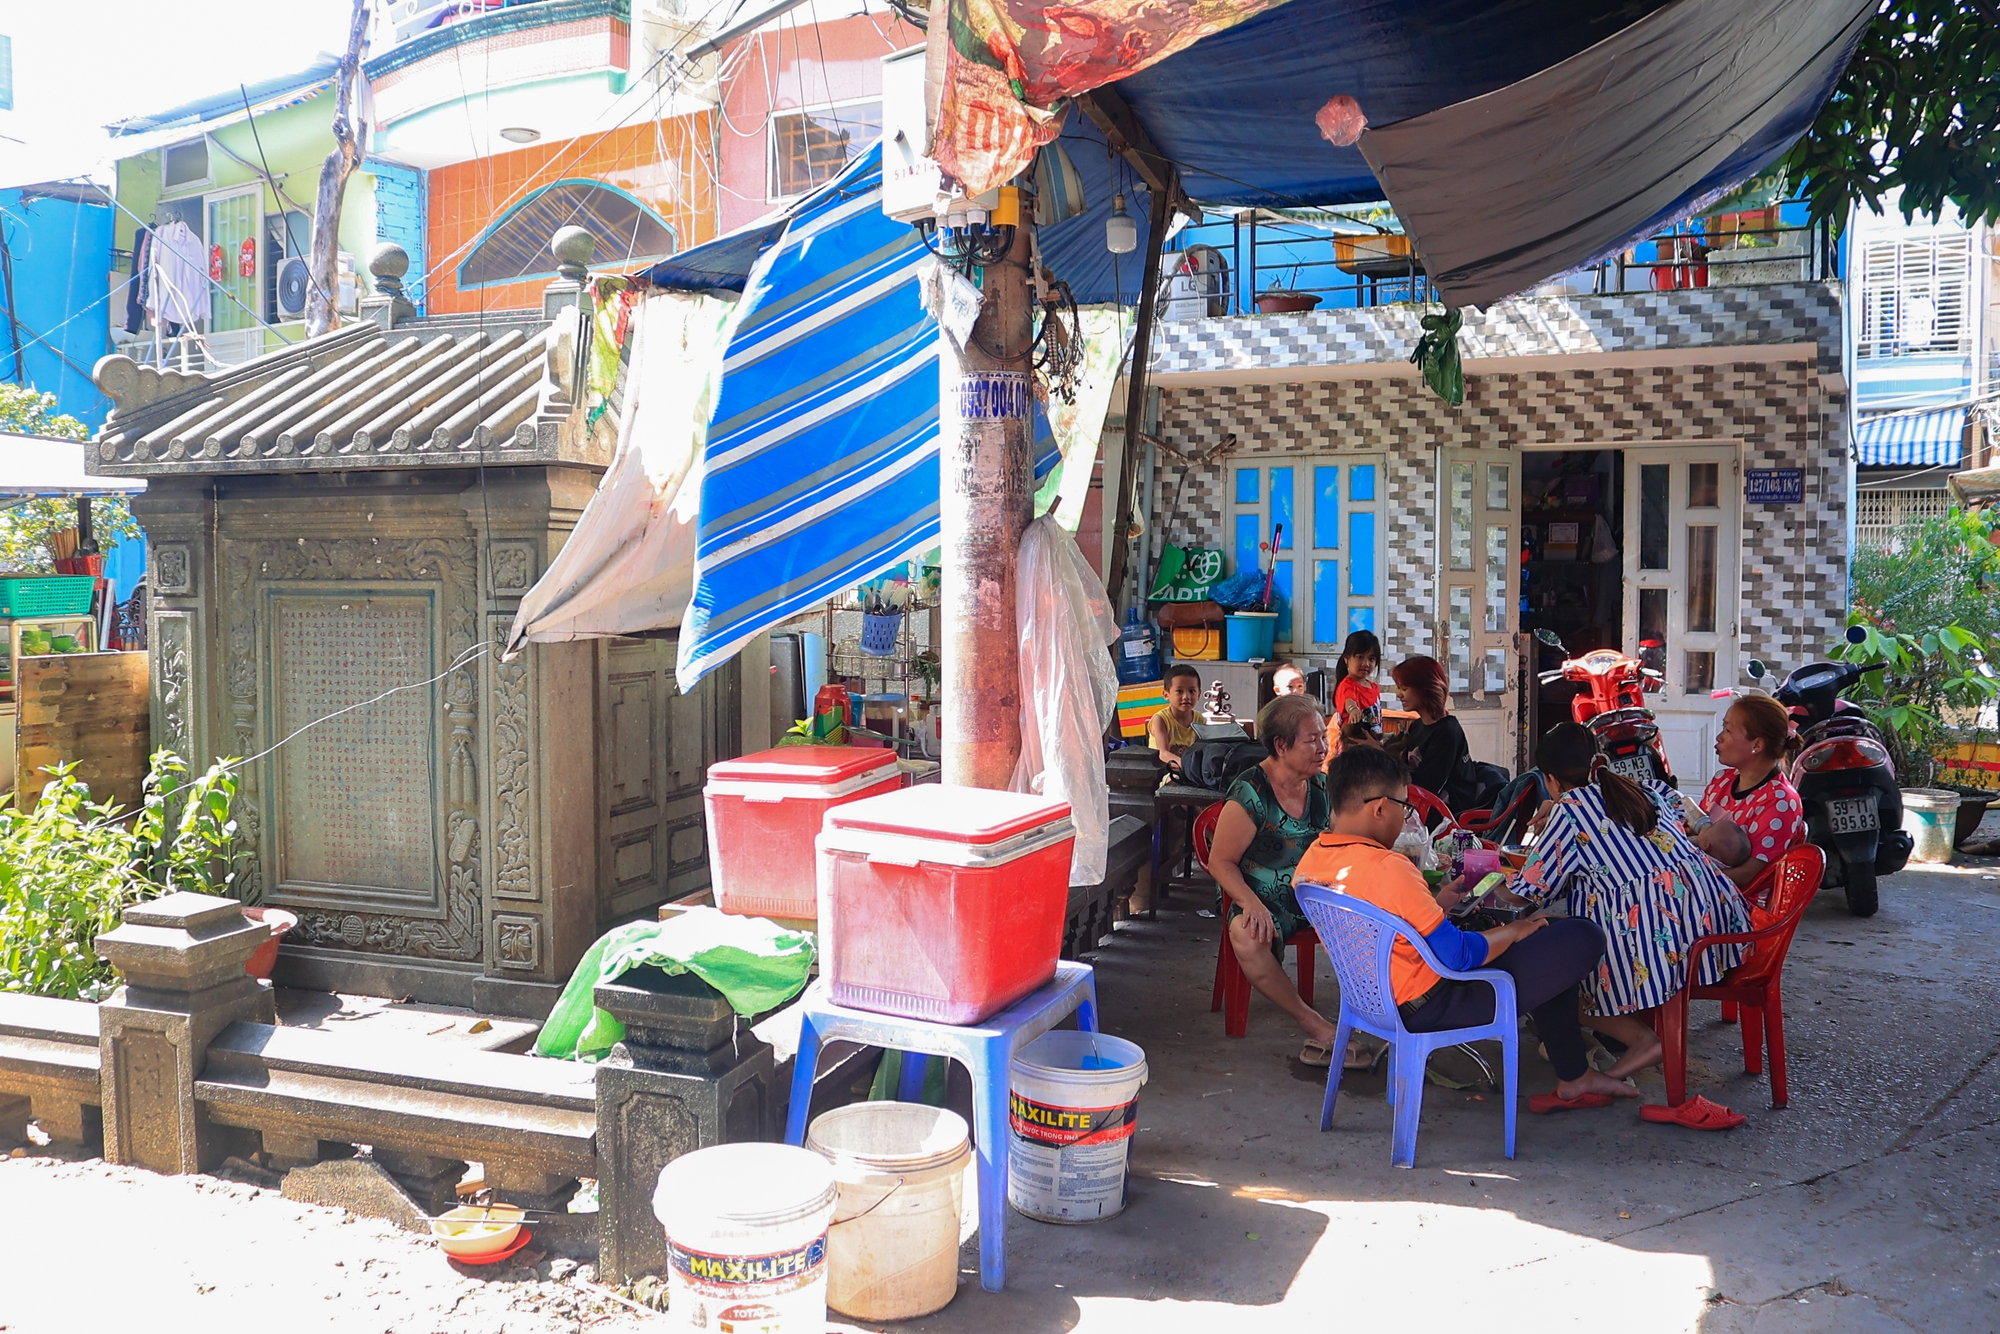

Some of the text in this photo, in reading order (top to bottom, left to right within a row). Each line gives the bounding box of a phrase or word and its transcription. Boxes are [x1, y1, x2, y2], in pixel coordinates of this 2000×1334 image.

[1181, 278, 1197, 292] LG
[1750, 478, 1800, 494] 127/103/18/7
[1613, 757, 1645, 774] 59-N3
[1833, 799, 1868, 816] 59-T1
[1832, 813, 1877, 832] 395.83
[1010, 1096, 1091, 1129] MAXILITE
[1040, 1130, 1063, 1140] TRONG
[690, 1251, 806, 1281] MAXILITE
[733, 1308, 766, 1319] TOTA
